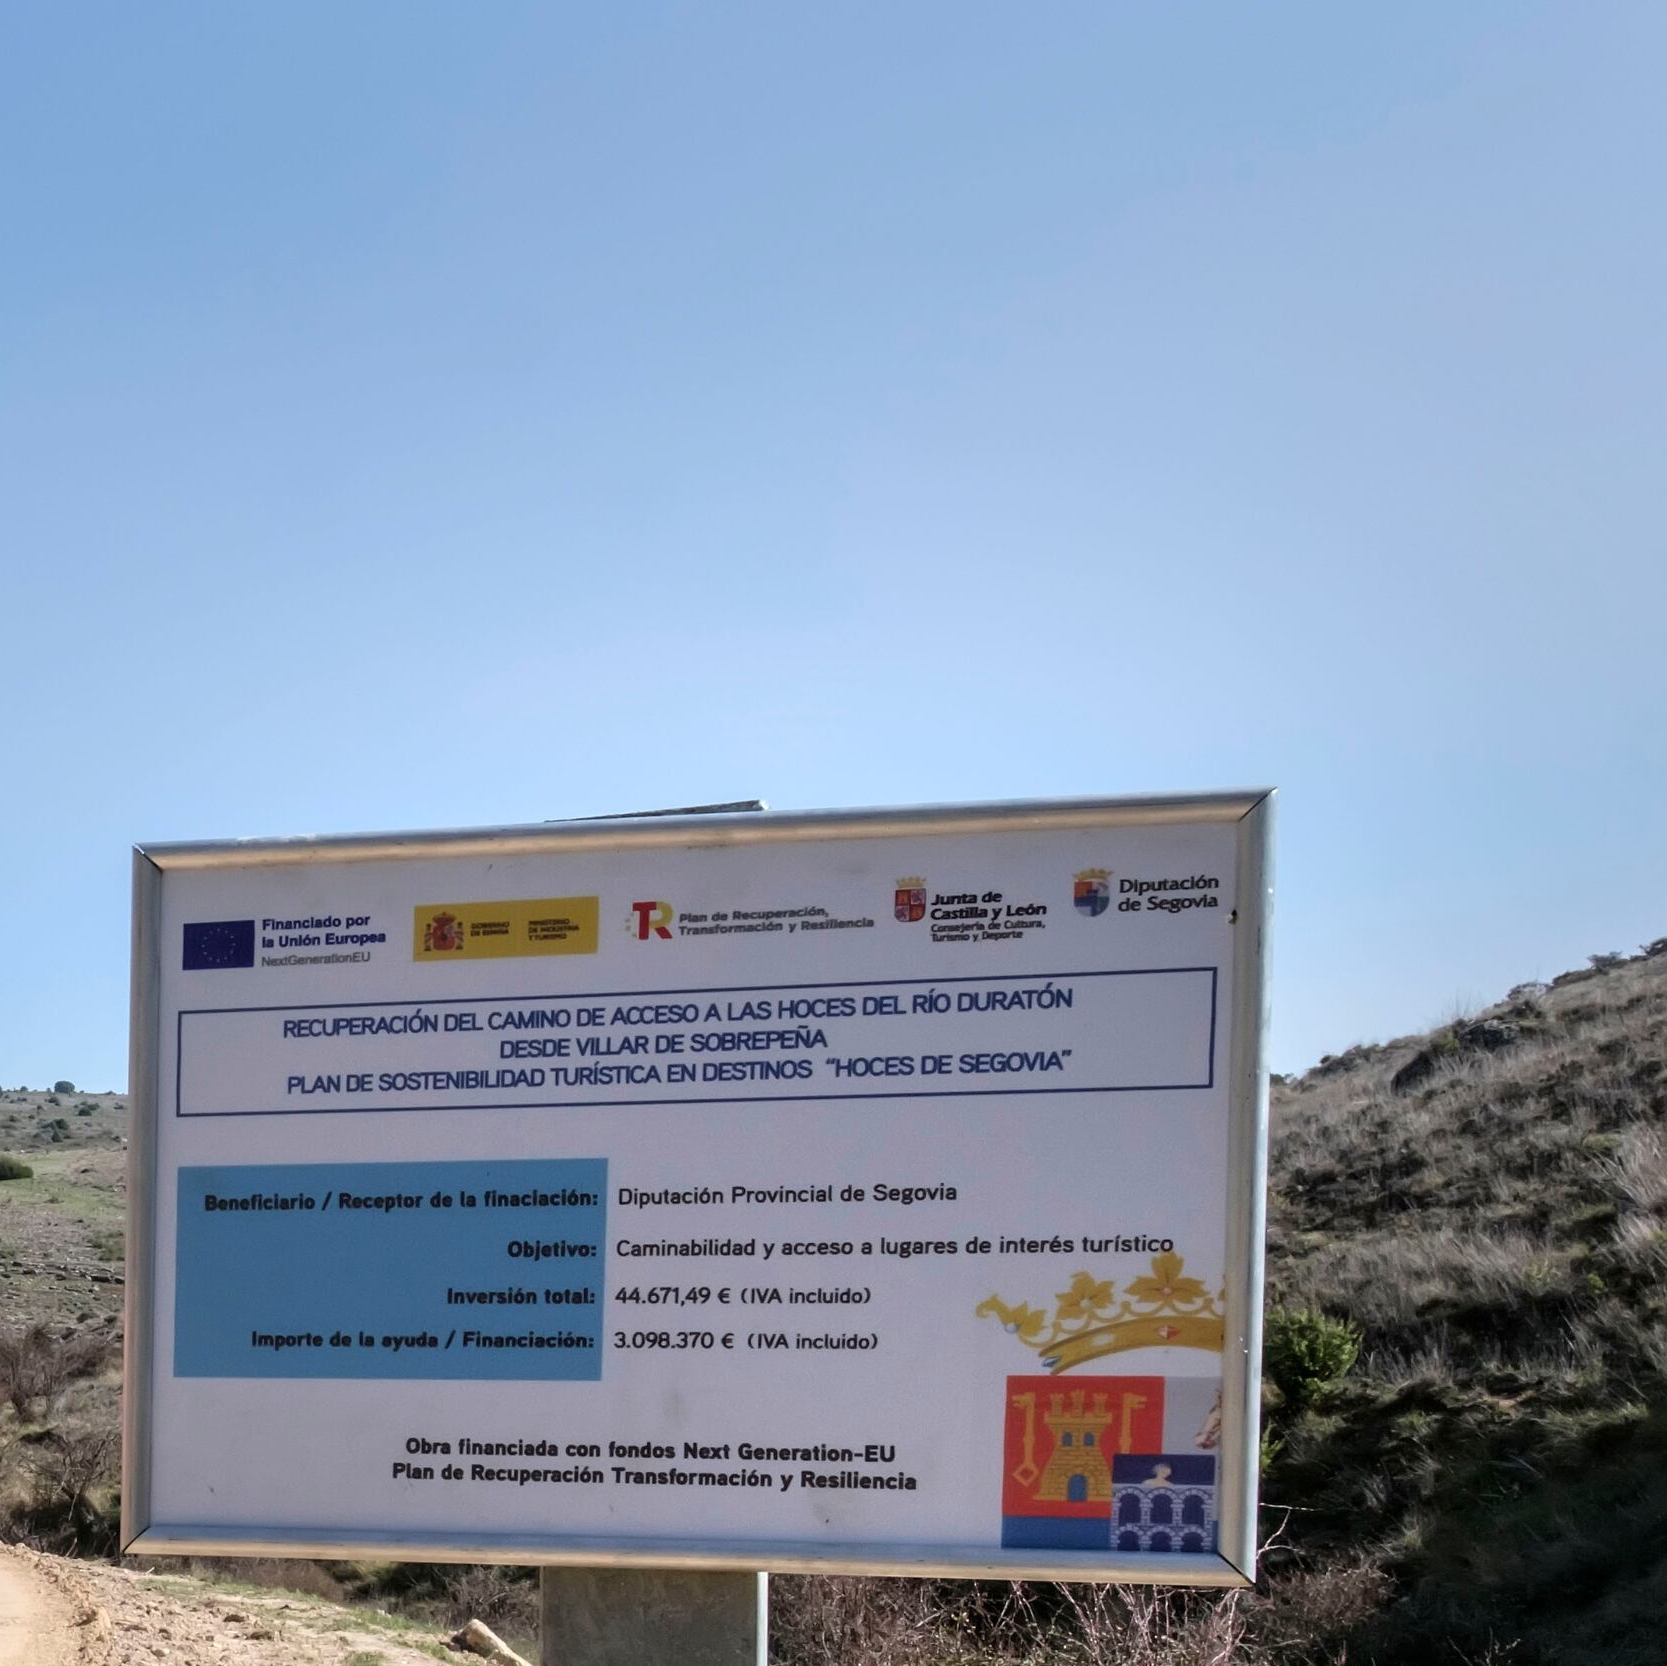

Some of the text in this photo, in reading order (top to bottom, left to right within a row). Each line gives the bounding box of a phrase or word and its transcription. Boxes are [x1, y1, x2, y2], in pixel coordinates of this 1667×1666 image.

[1119, 875, 1219, 896] Diputación
[931, 891, 1003, 905] Junta de
[1118, 893, 1219, 913] de Segovia
[679, 906, 829, 924] Plan de Recuperación,
[930, 903, 1047, 922] Castilla y León
[262, 916, 371, 930] Financiado por
[679, 917, 875, 936] Transformación y Resiliencia
[931, 920, 1046, 933] Consejería de Cultura,
[262, 933, 386, 948] la Unión Europea
[931, 931, 1023, 942] Turismo y Deporte
[262, 951, 371, 967] NextGenerationEU
[283, 982, 1074, 1038] RECUPERACIÓN DEL CAMINO DE ACCESO A LAS HOCES DEL RÍO DURATÓN
[499, 1025, 827, 1059] DESDE VILLAR DE SOBREPEÑA
[287, 1075, 341, 1095] PLAN
[346, 1072, 373, 1092] DE
[378, 1067, 545, 1092] SOSTENIBILIDAD
[550, 1061, 661, 1087] TURÍSTICA
[667, 1063, 696, 1083] EN
[702, 1059, 813, 1082] DESTINOS
[921, 1054, 953, 1075] DE
[204, 1188, 598, 1212] Beneficiario / Receptor de la finaciación:
[618, 1184, 957, 1209] Diputación Provincial de Segovia
[507, 1240, 598, 1261] Objetivo:
[616, 1235, 1174, 1260] Caminabilidad y acceso a lugares de interés turístico
[447, 1288, 595, 1305] Inversión total:
[615, 1286, 871, 1307] 44.671,49 € (IVA incluido)
[251, 1331, 595, 1352] Importe de la ayuda / Financiación:
[613, 1331, 878, 1350] 3.098.370 € (IVA incluido)
[405, 1437, 896, 1463] Obra financiada con fondos Next Generation-EU
[392, 1463, 917, 1491] Plan de Recuperación Transformación y Resiliencia
